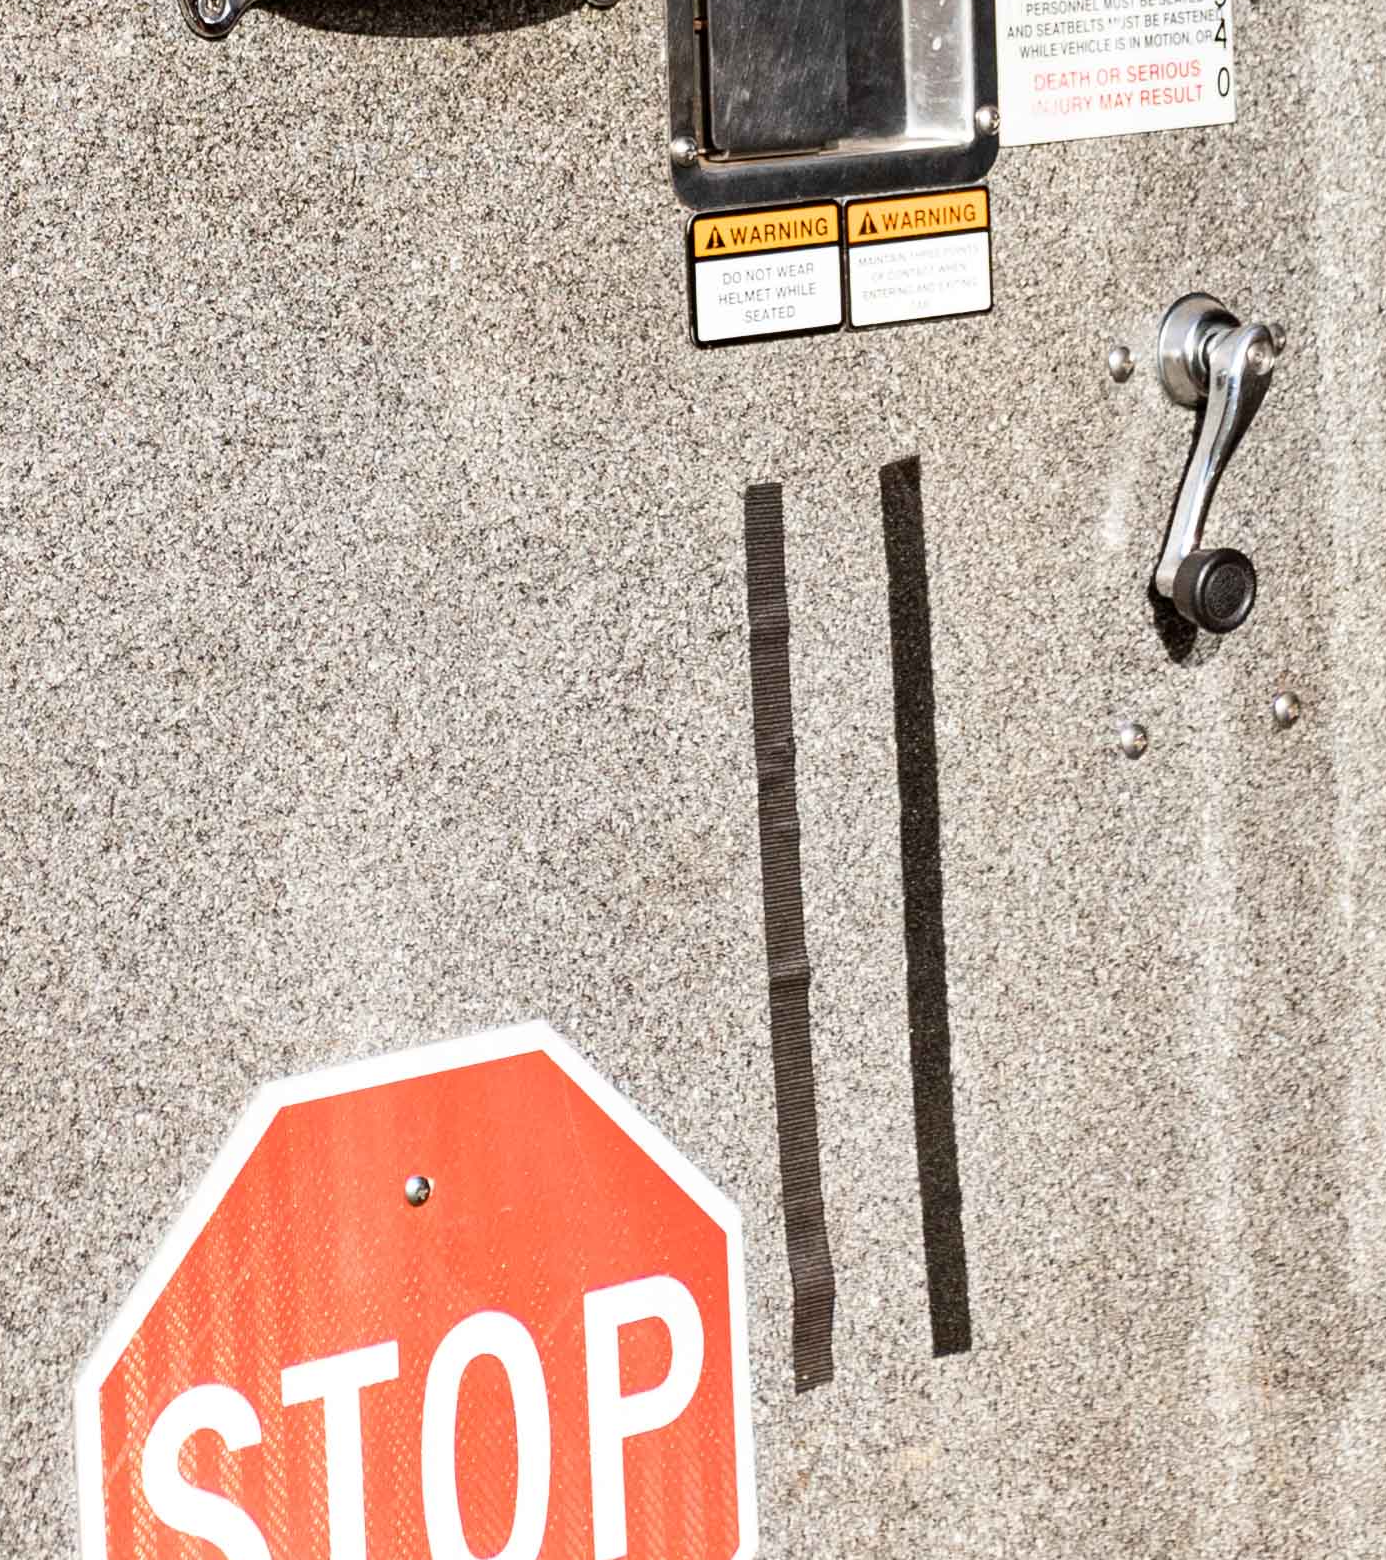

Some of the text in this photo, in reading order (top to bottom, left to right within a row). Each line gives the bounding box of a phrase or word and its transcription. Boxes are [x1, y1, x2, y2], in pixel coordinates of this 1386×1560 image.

[1025, 0, 1098, 17] PERSONNEL
[1006, 23, 1033, 40] AND
[1036, 17, 1104, 38] SEATBELTS
[1144, 13, 1160, 28] BE
[1019, 42, 1057, 60] WHILE
[1060, 38, 1111, 57] VEHICLE
[1114, 36, 1127, 51] IS
[1129, 35, 1141, 50] IN
[1195, 28, 1214, 44] OR
[1033, 58, 1202, 93] DEATH OR SERIOUS
[1098, 91, 1135, 111] MAY
[1139, 83, 1204, 107] RESULT
[881, 202, 977, 233] WARNING
[729, 216, 829, 247] WARNING
[721, 261, 815, 285] DO NOT WEAR
[718, 282, 817, 306] HELMET WHILE
[743, 305, 797, 324] SEATED
